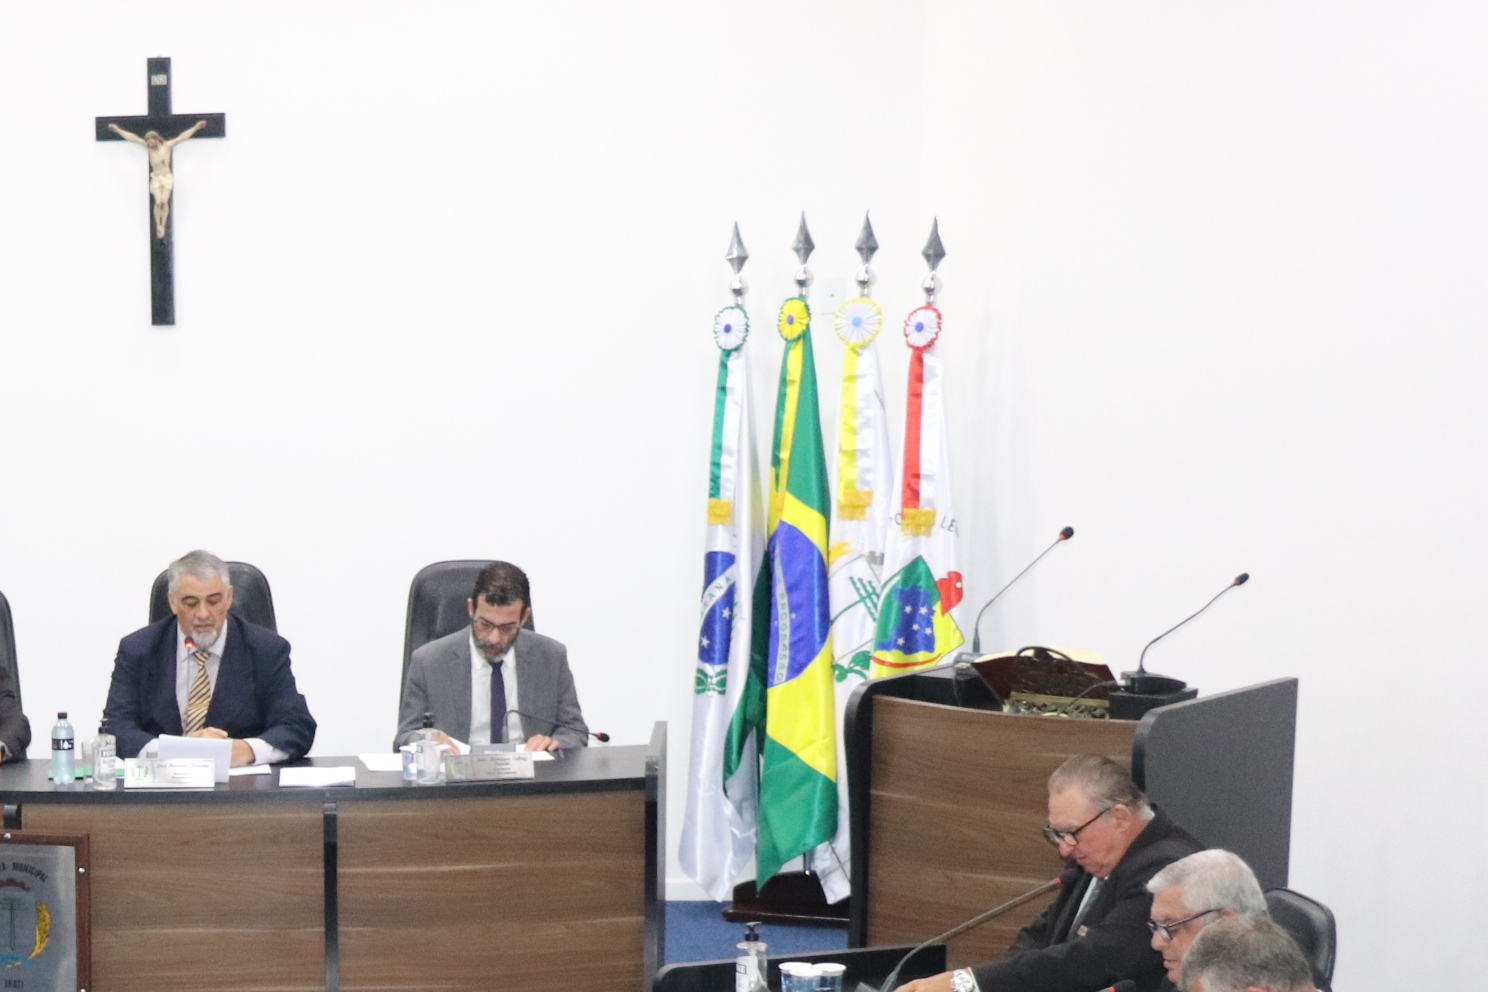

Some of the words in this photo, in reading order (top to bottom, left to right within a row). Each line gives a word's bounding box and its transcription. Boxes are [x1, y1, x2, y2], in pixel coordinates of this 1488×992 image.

[151, 74, 168, 86] INRI
[12, 861, 49, 883] MUNICIPAL
[4, 979, 24, 989] IRATI
